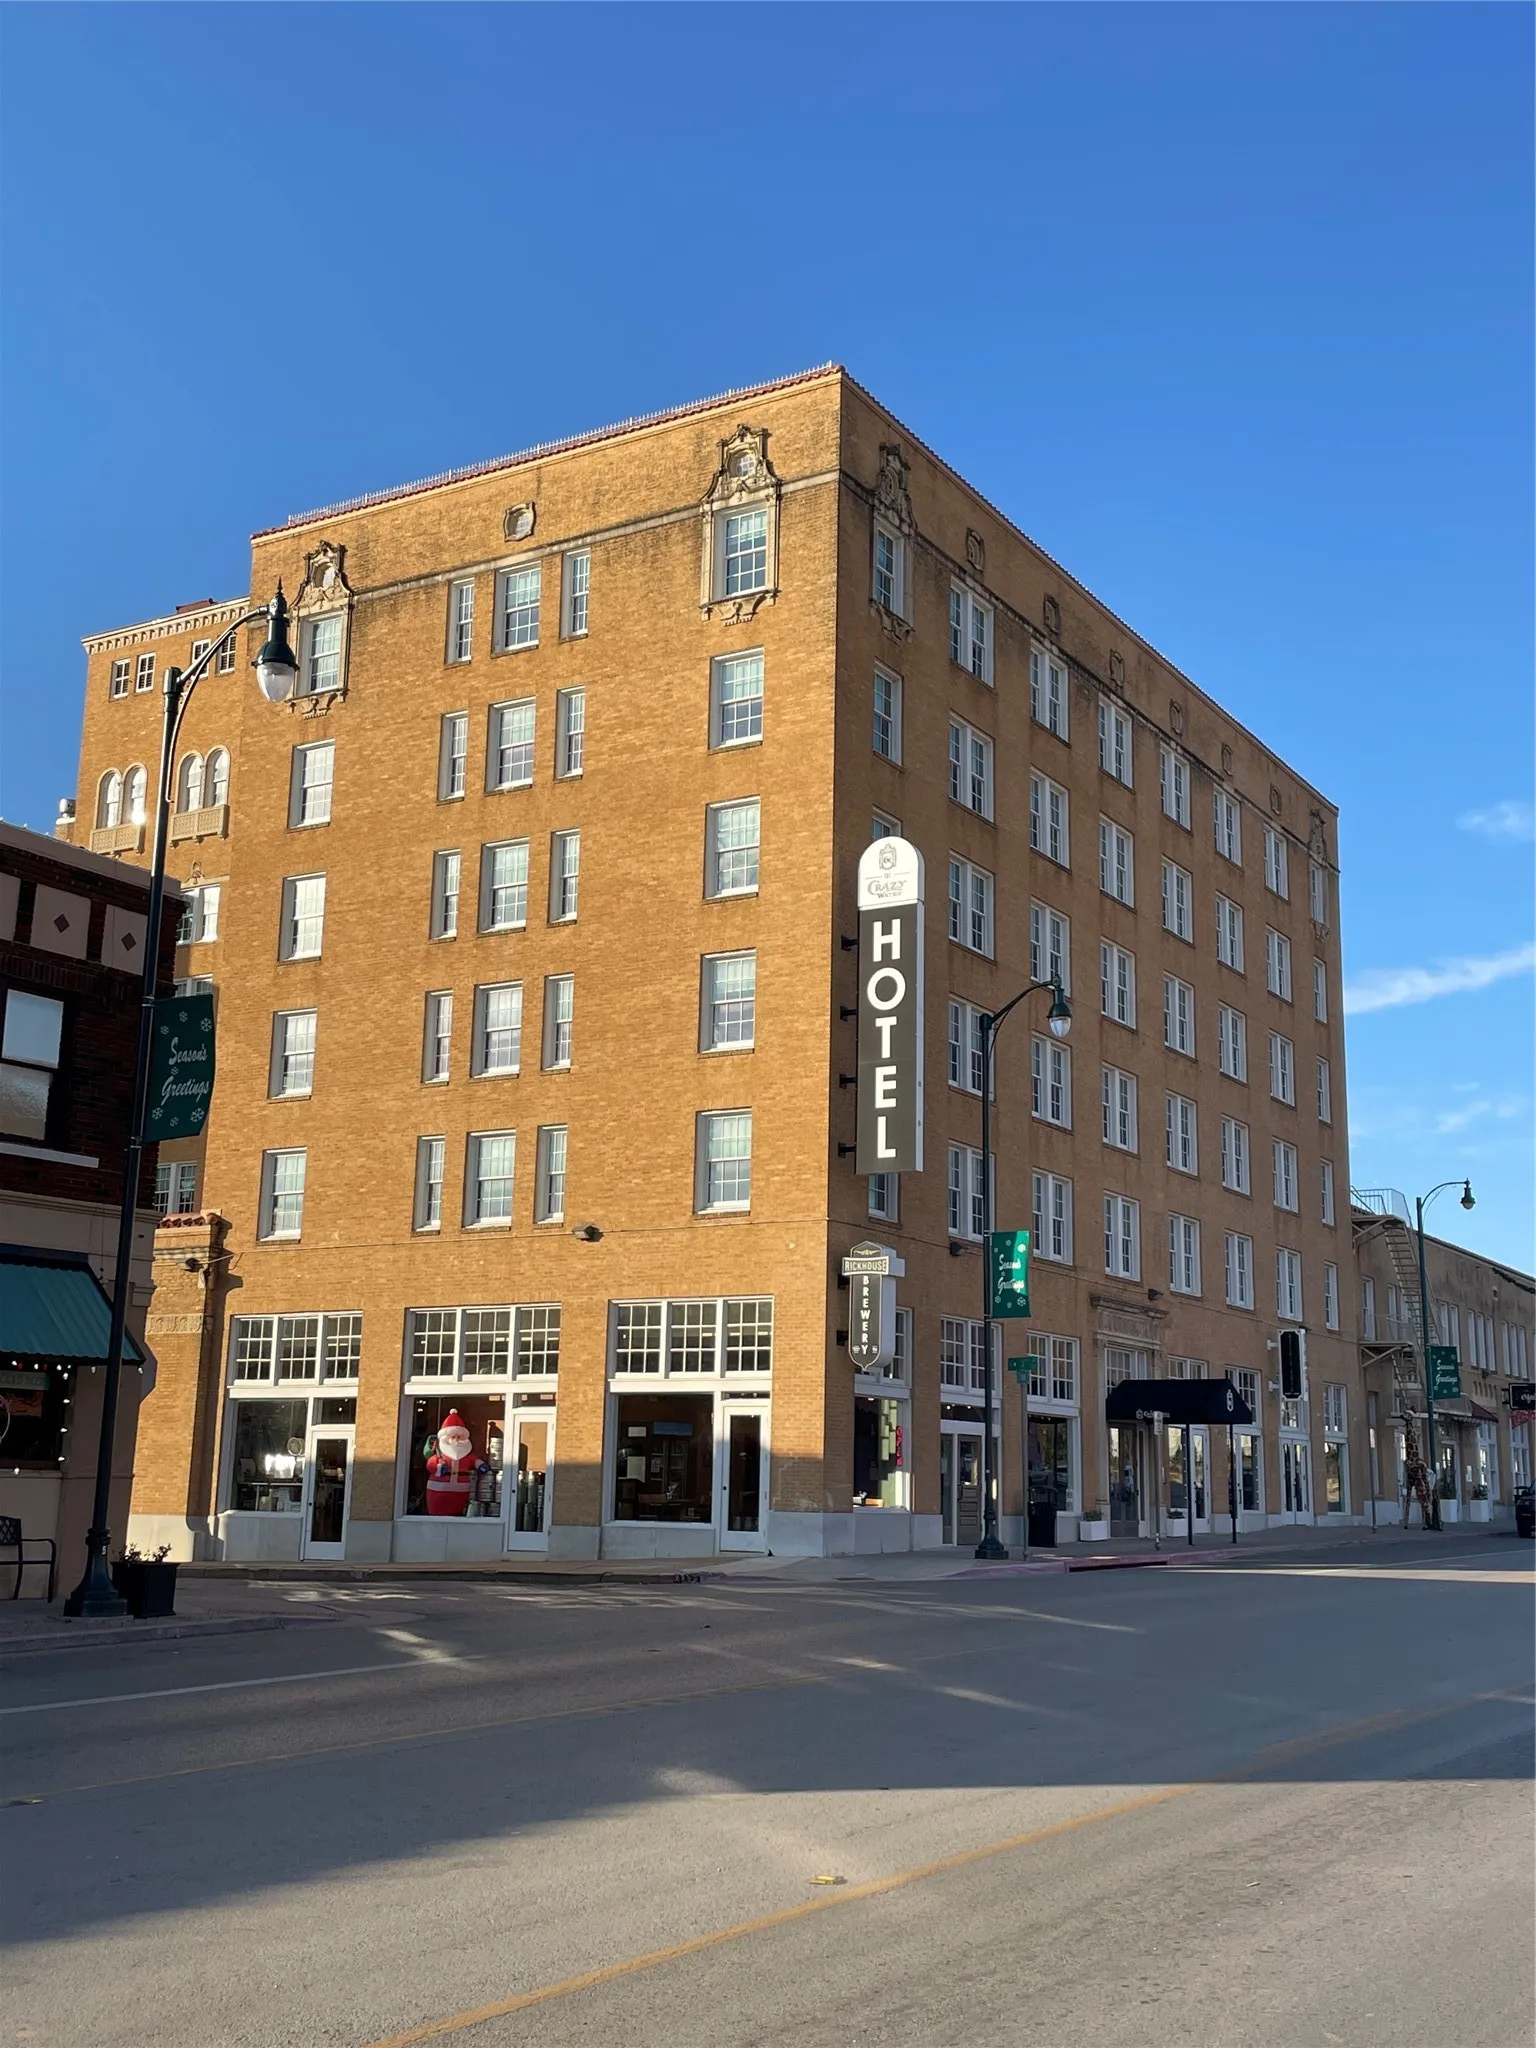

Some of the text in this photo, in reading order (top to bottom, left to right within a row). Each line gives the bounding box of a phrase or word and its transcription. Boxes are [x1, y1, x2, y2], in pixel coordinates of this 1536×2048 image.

[867, 880, 907, 895] CRAZY
[168, 1036, 208, 1065] Season's
[867, 919, 906, 1159] HOTEL
[161, 1075, 210, 1106] Greetings
[844, 1260, 887, 1272] RICKHOUSE
[860, 1275, 871, 1355] BREWERY
